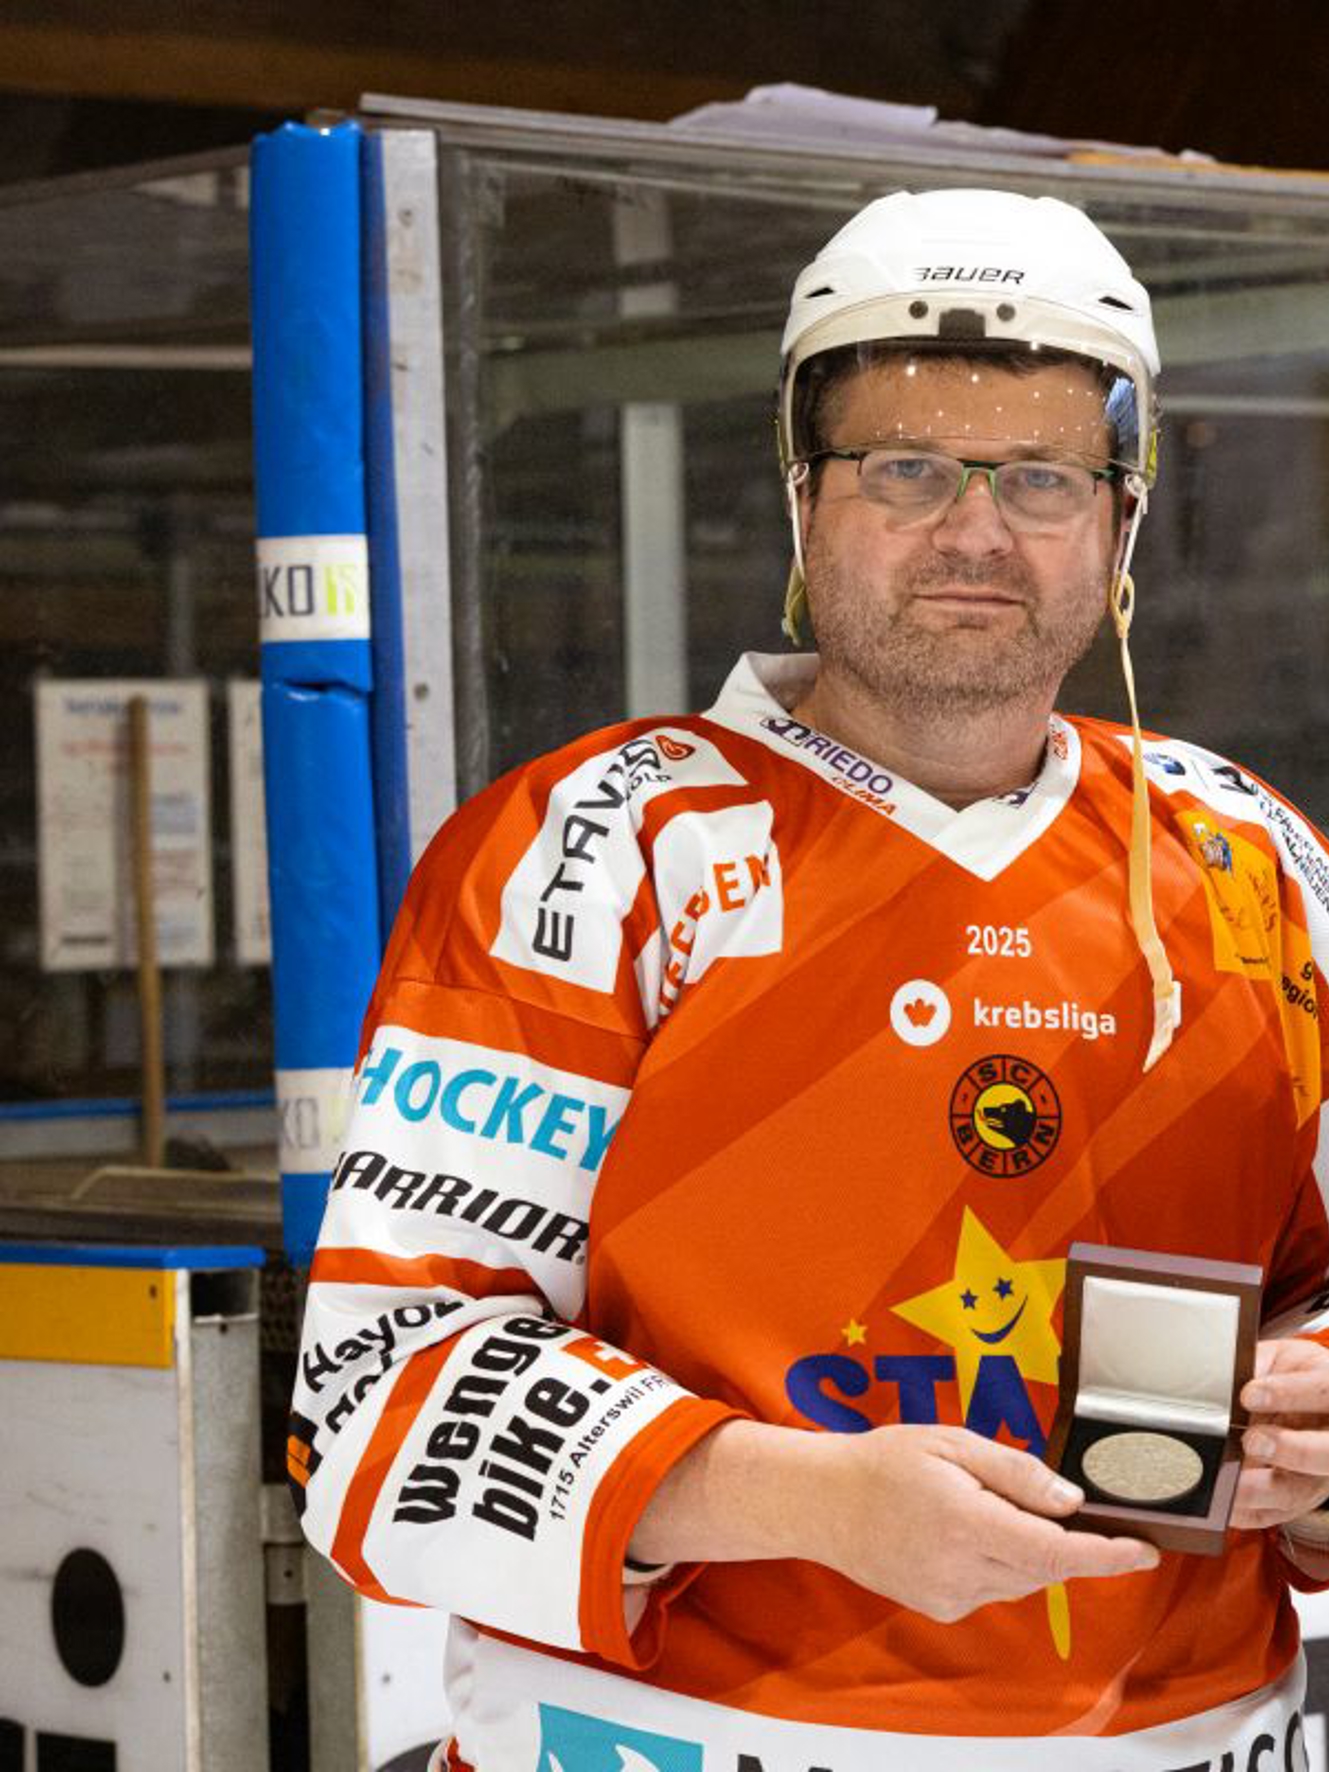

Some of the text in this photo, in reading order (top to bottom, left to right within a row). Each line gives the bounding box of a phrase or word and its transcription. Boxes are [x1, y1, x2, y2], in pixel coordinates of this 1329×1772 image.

[803, 734, 893, 796] RIEDO
[966, 925, 1032, 957] 2025
[973, 998, 1117, 1040] krebsliga
[361, 1047, 620, 1172] HOCKEY
[332, 1150, 589, 1262] ARRIOR
[392, 1315, 573, 1524] wenge
[549, 1469, 576, 1521] 1715
[571, 1389, 646, 1468] Alterswil
[785, 1353, 1060, 1461] STA
